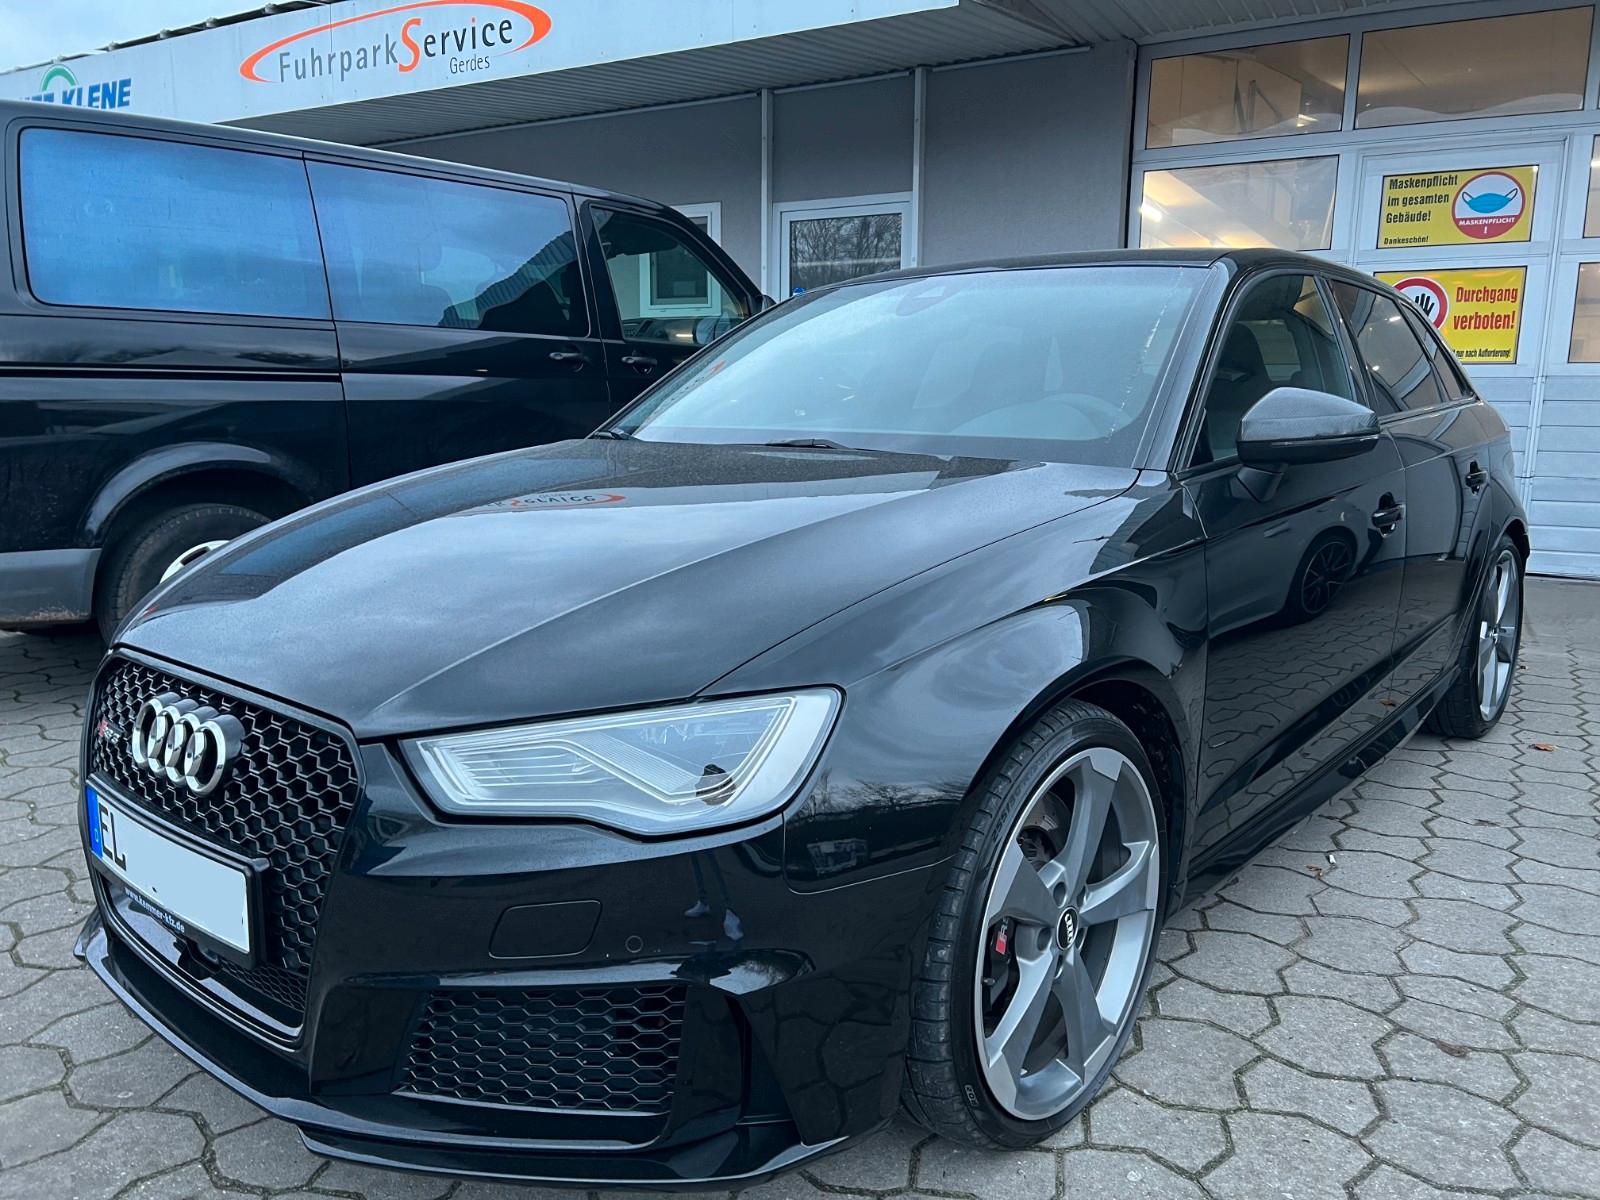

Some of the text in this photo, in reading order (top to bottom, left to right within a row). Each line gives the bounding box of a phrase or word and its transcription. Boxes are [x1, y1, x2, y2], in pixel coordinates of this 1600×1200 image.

[279, 17, 513, 83] FuhrparkService
[449, 55, 490, 74] Gerdes
[1389, 174, 1458, 190] Maskenpflicht
[1387, 193, 1450, 207] im gesamten
[1386, 211, 1431, 224] Gebäude!
[1458, 217, 1515, 226] MASKENPFLICHT
[1384, 235, 1429, 245] Dankeschön!
[1455, 286, 1518, 304] Durchgang
[1453, 311, 1515, 331] verboten!
[99, 802, 127, 872] EL
